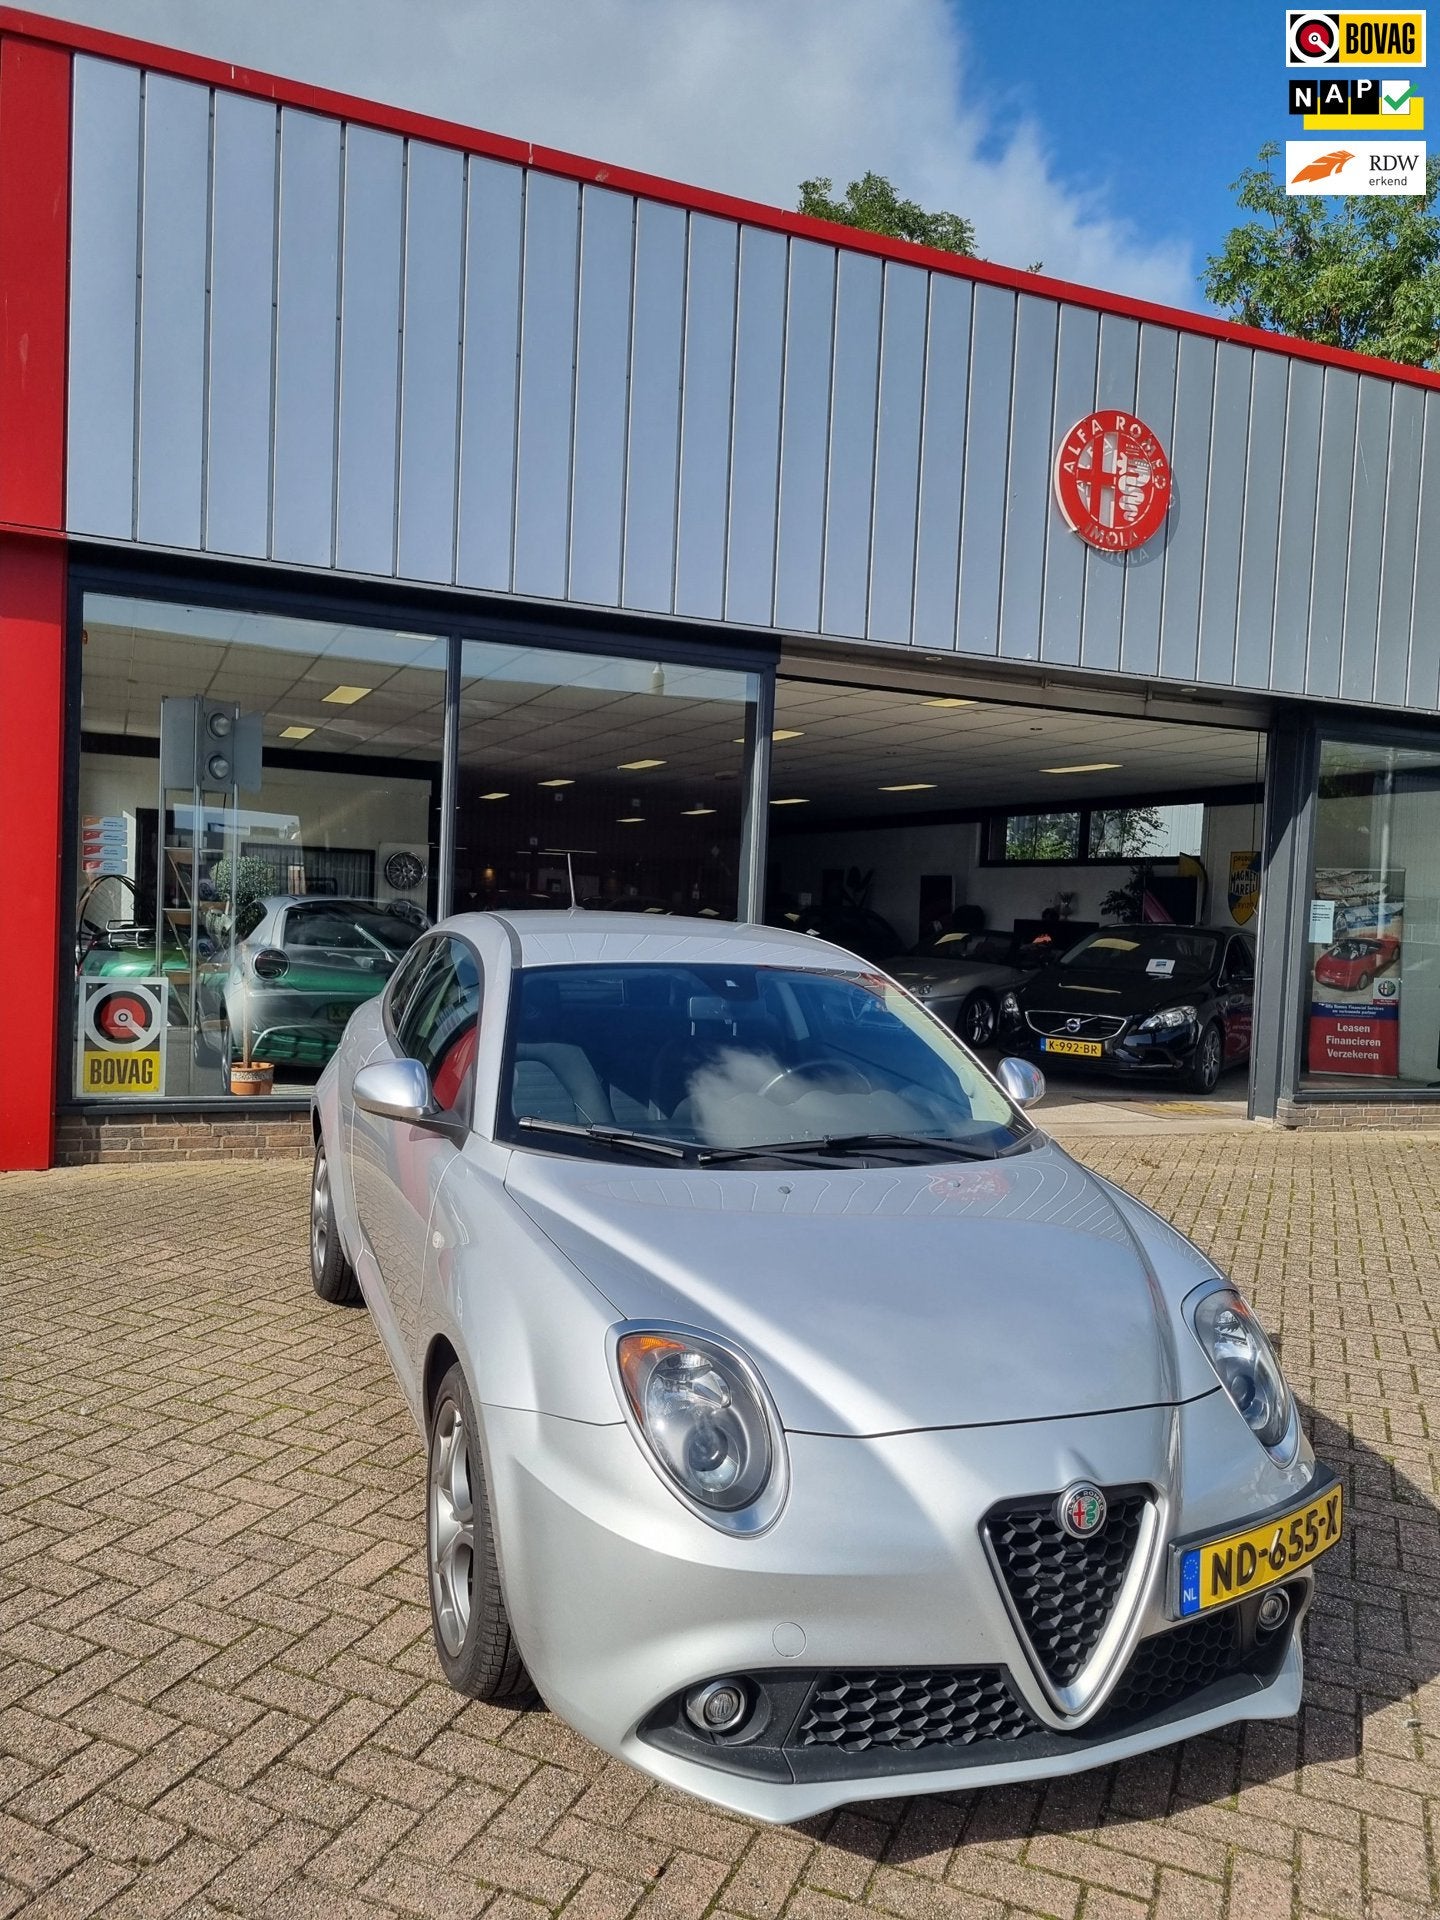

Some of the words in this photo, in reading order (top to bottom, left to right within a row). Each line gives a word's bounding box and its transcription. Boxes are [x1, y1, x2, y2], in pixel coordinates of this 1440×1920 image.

[1063, 418, 1103, 476] ALFA
[1115, 415, 1166, 490] ROMEO
[1337, 1022, 1371, 1033] Leasen
[1049, 1040, 1098, 1055] K-992-BR
[1326, 1035, 1381, 1047] Financieren
[1327, 1048, 1379, 1060] Verzekeren
[90, 1058, 153, 1085] BOVAG
[1212, 1495, 1338, 1596] ND-655-X
[1183, 1588, 1197, 1603] NL
